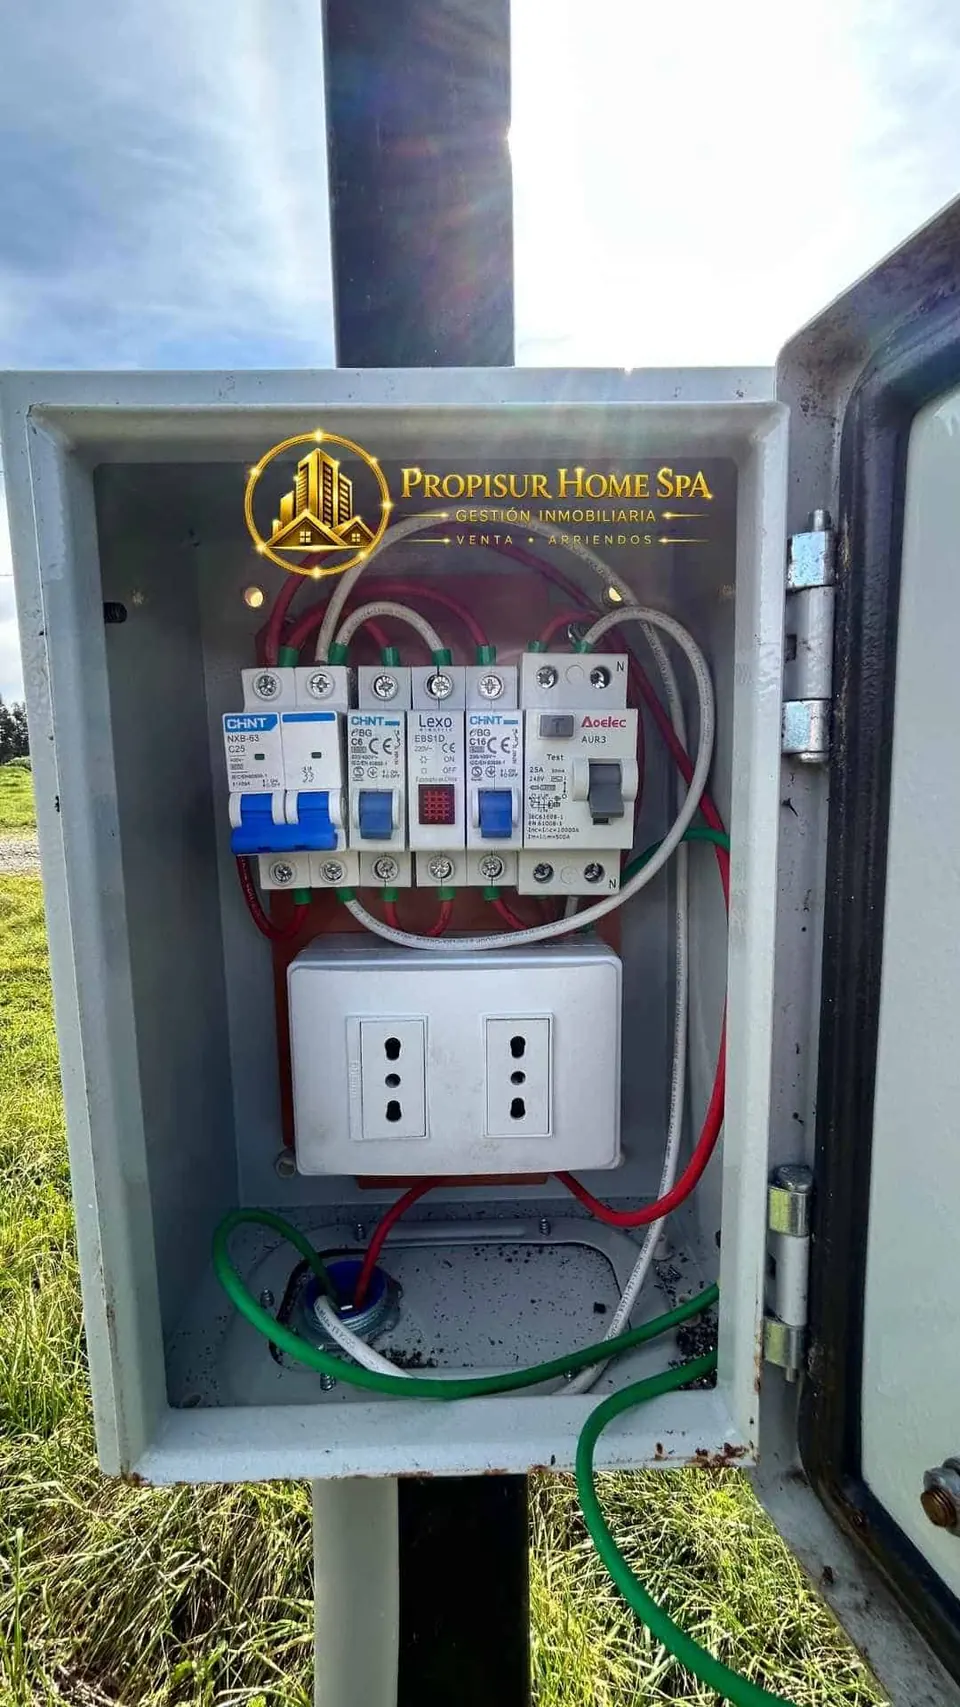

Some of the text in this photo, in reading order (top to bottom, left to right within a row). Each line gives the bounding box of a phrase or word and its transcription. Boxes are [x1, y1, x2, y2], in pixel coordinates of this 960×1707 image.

[616, 661, 624, 672] N
[227, 717, 267, 729] CHNT
[351, 716, 384, 726] CHNT
[419, 714, 452, 728] Lexo
[470, 715, 503, 725] CHNT
[581, 715, 627, 728] Aoelec
[227, 734, 260, 743] NXB-63
[351, 738, 363, 746] C6
[414, 734, 445, 743] EBS1D
[469, 738, 487, 746] C16
[581, 735, 607, 743] AUR3
[228, 745, 245, 753] C25
[443, 755, 455, 763] ON
[546, 753, 564, 761] Test
[442, 766, 458, 774] OFF
[609, 879, 617, 889] N
